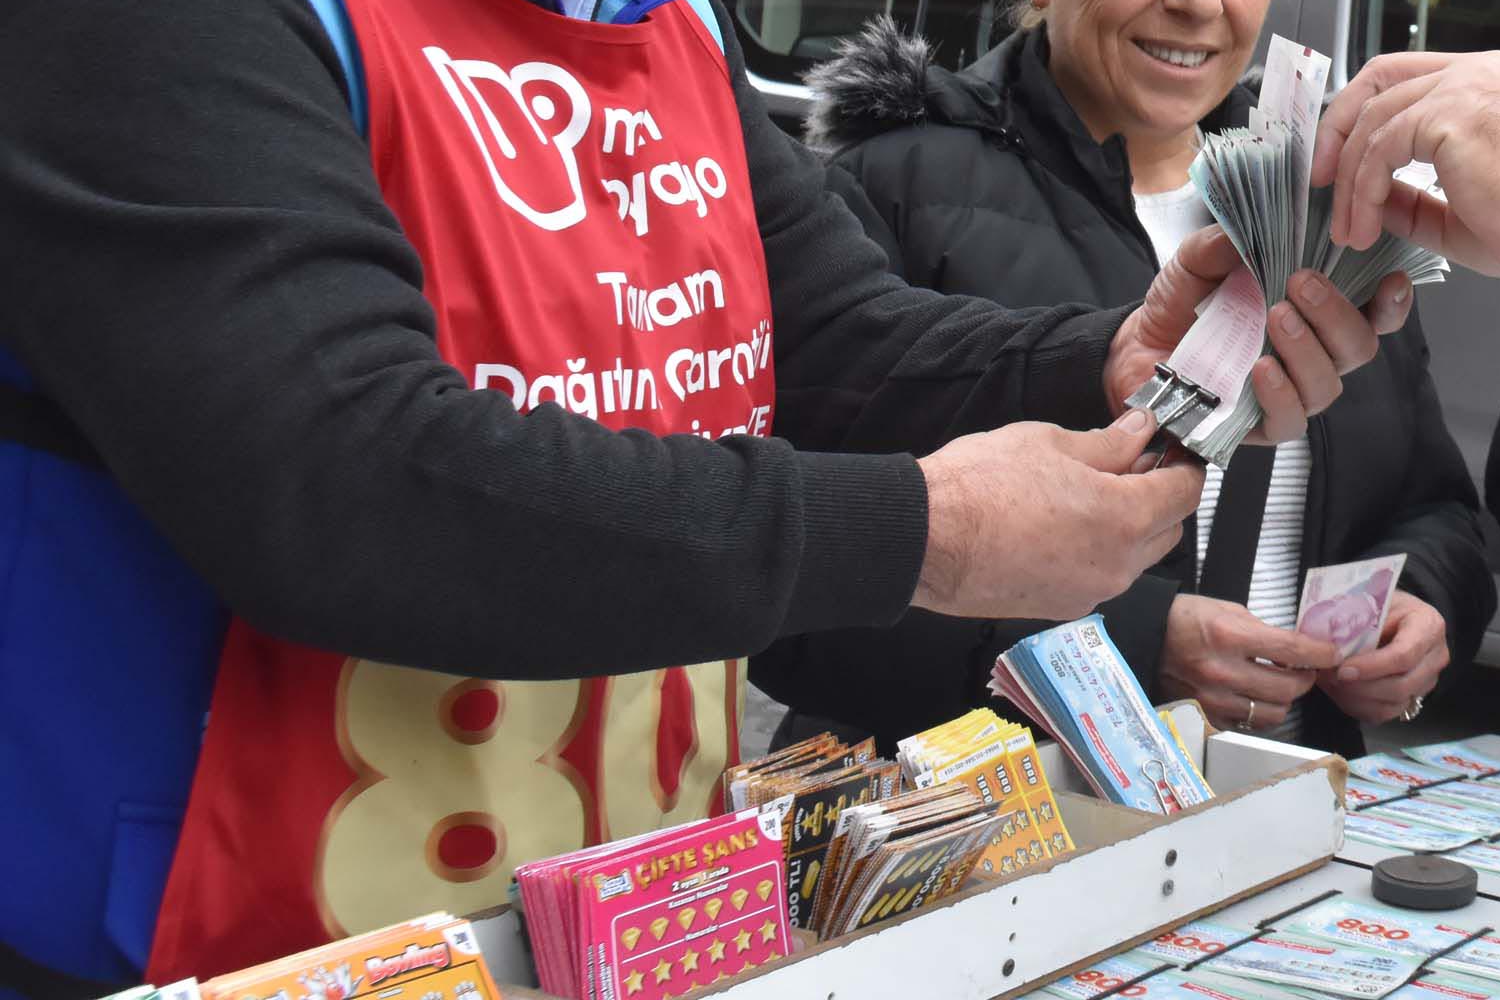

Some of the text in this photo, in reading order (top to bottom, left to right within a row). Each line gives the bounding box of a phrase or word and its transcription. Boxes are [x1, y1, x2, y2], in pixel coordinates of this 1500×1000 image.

[703, 829, 758, 868] ŞANS
[1337, 918, 1410, 940] 800
[365, 944, 449, 986] Bowling
